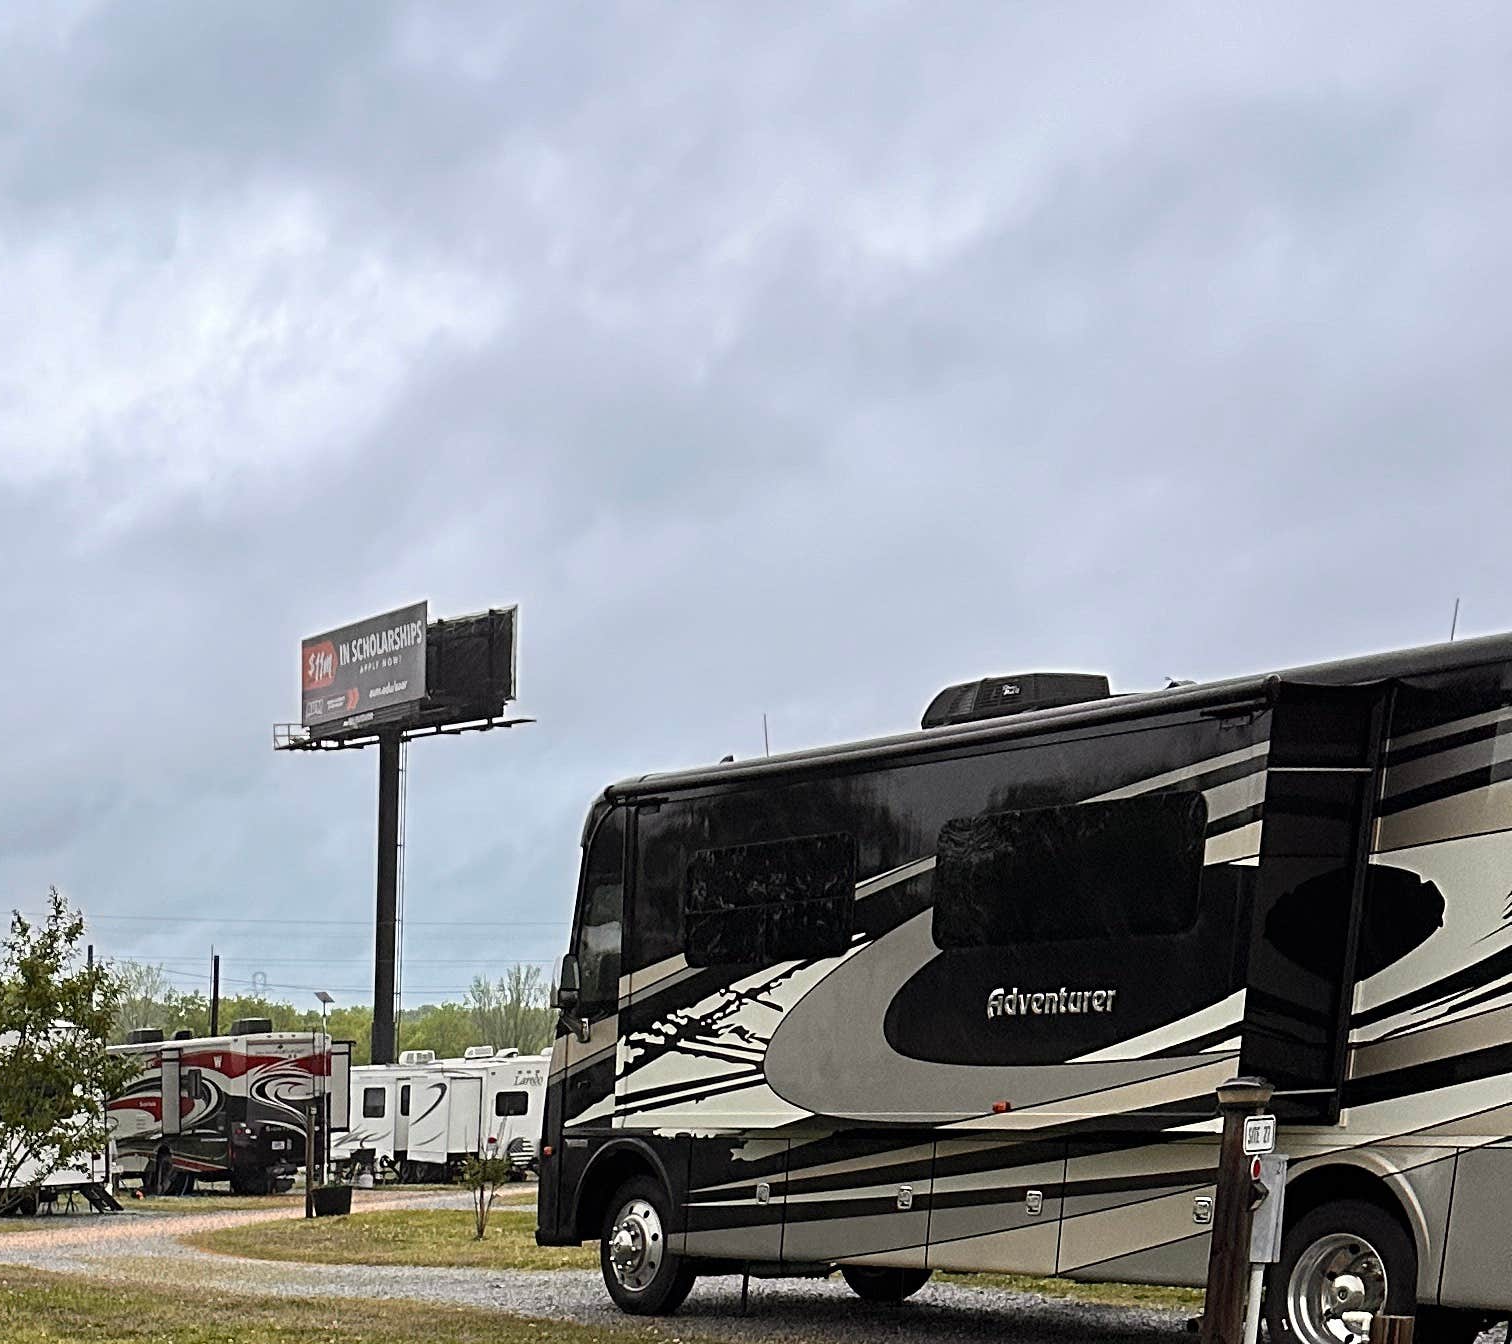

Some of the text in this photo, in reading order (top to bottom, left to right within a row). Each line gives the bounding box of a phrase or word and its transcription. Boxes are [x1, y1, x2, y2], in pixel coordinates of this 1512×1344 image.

[339, 620, 422, 666] IN SCHOLARSHIPS
[987, 986, 1117, 1020] Adventurer
